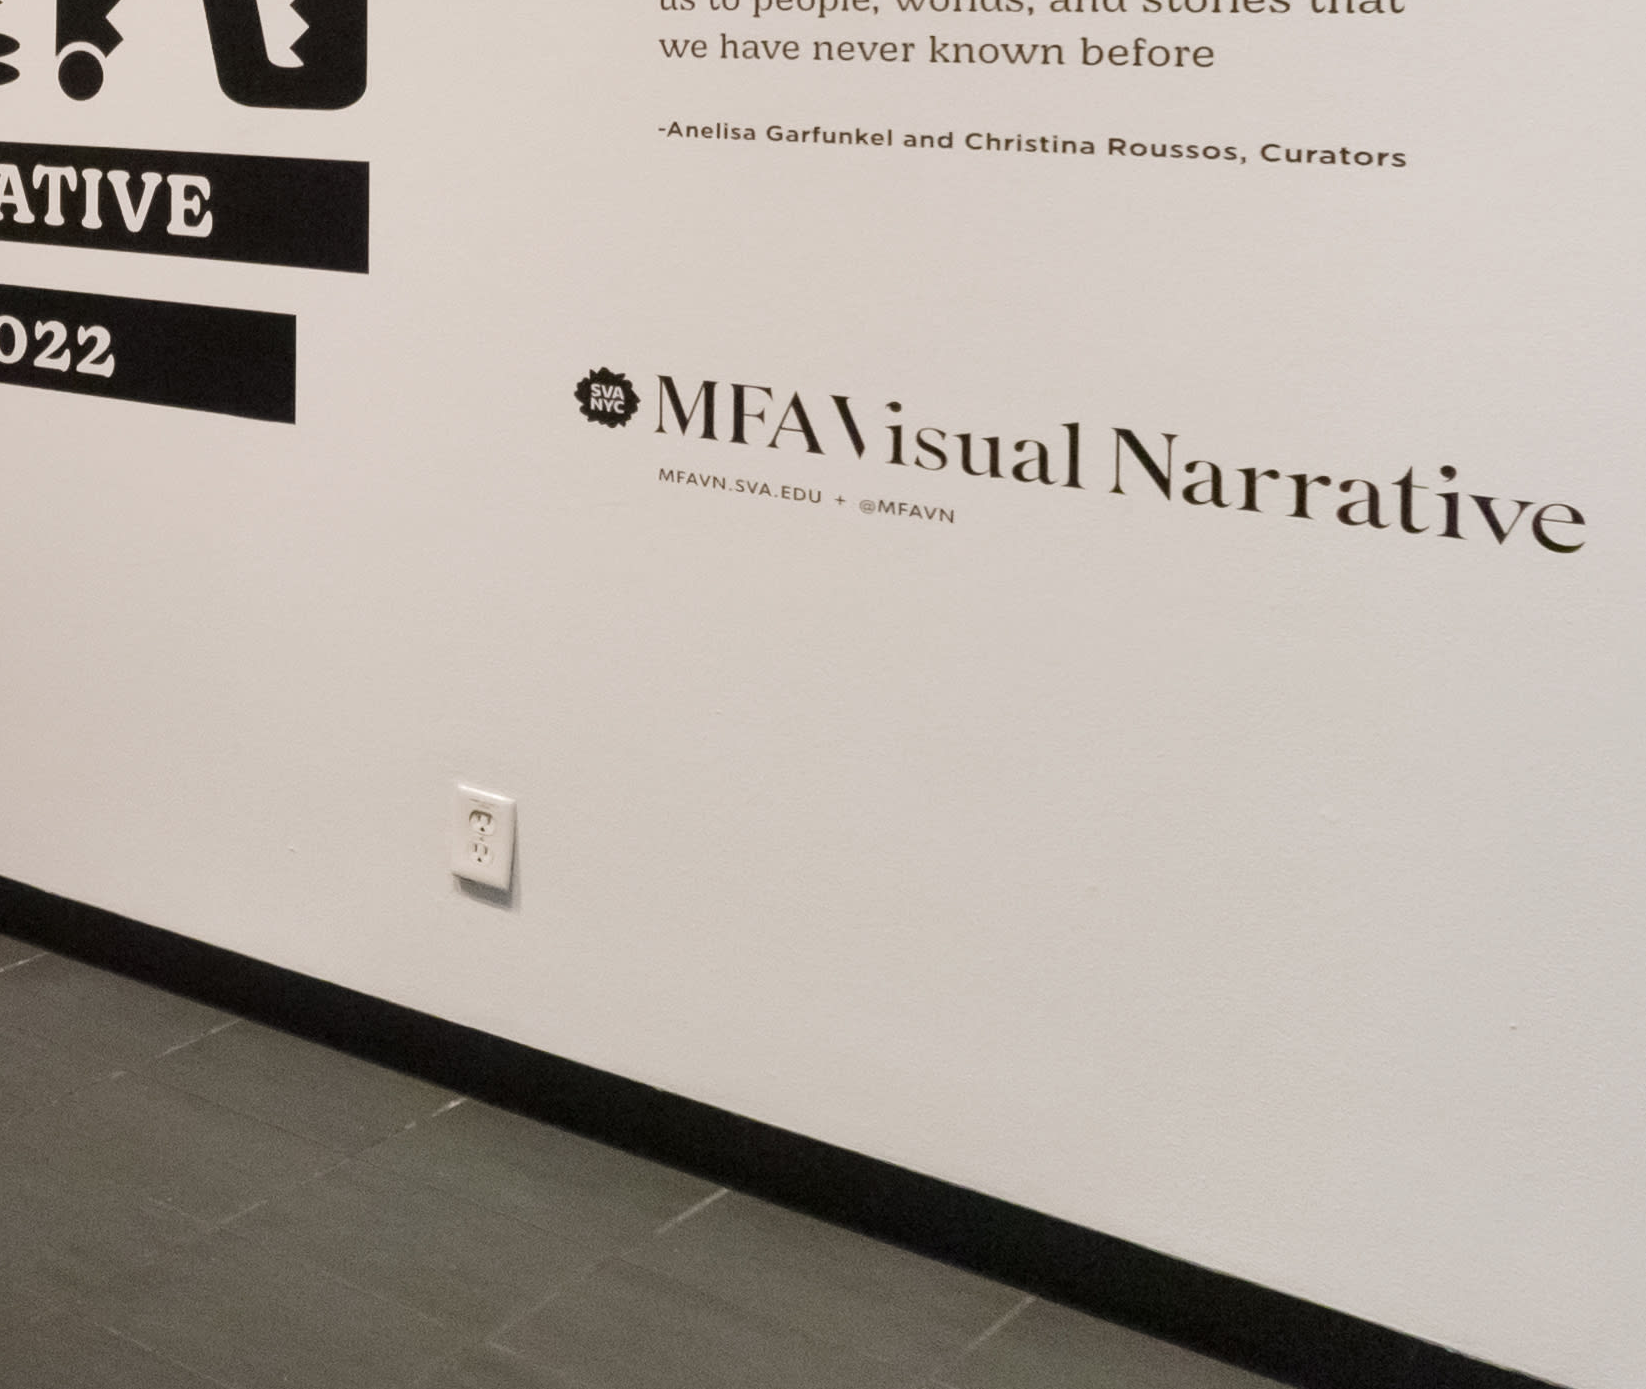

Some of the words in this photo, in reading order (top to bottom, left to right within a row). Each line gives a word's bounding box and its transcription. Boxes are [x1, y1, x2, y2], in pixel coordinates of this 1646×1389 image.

[658, 38, 708, 59] we
[719, 32, 800, 61] have
[812, 40, 916, 63] never
[928, 34, 1066, 66] known
[1079, 36, 1215, 69] before
[657, 120, 757, 141] -Anelisa
[765, 124, 893, 147] Garfunkel
[902, 131, 954, 150] and
[964, 131, 1096, 156] Christina
[1107, 137, 1247, 165] Roussos,
[1259, 142, 1408, 168] Curators
[589, 382, 625, 401] SVA
[590, 398, 626, 415] NYC
[658, 467, 823, 504] MFAVN.SVA.EDU
[858, 497, 956, 524] @MFAVN
[1110, 425, 1587, 555] Narrative
